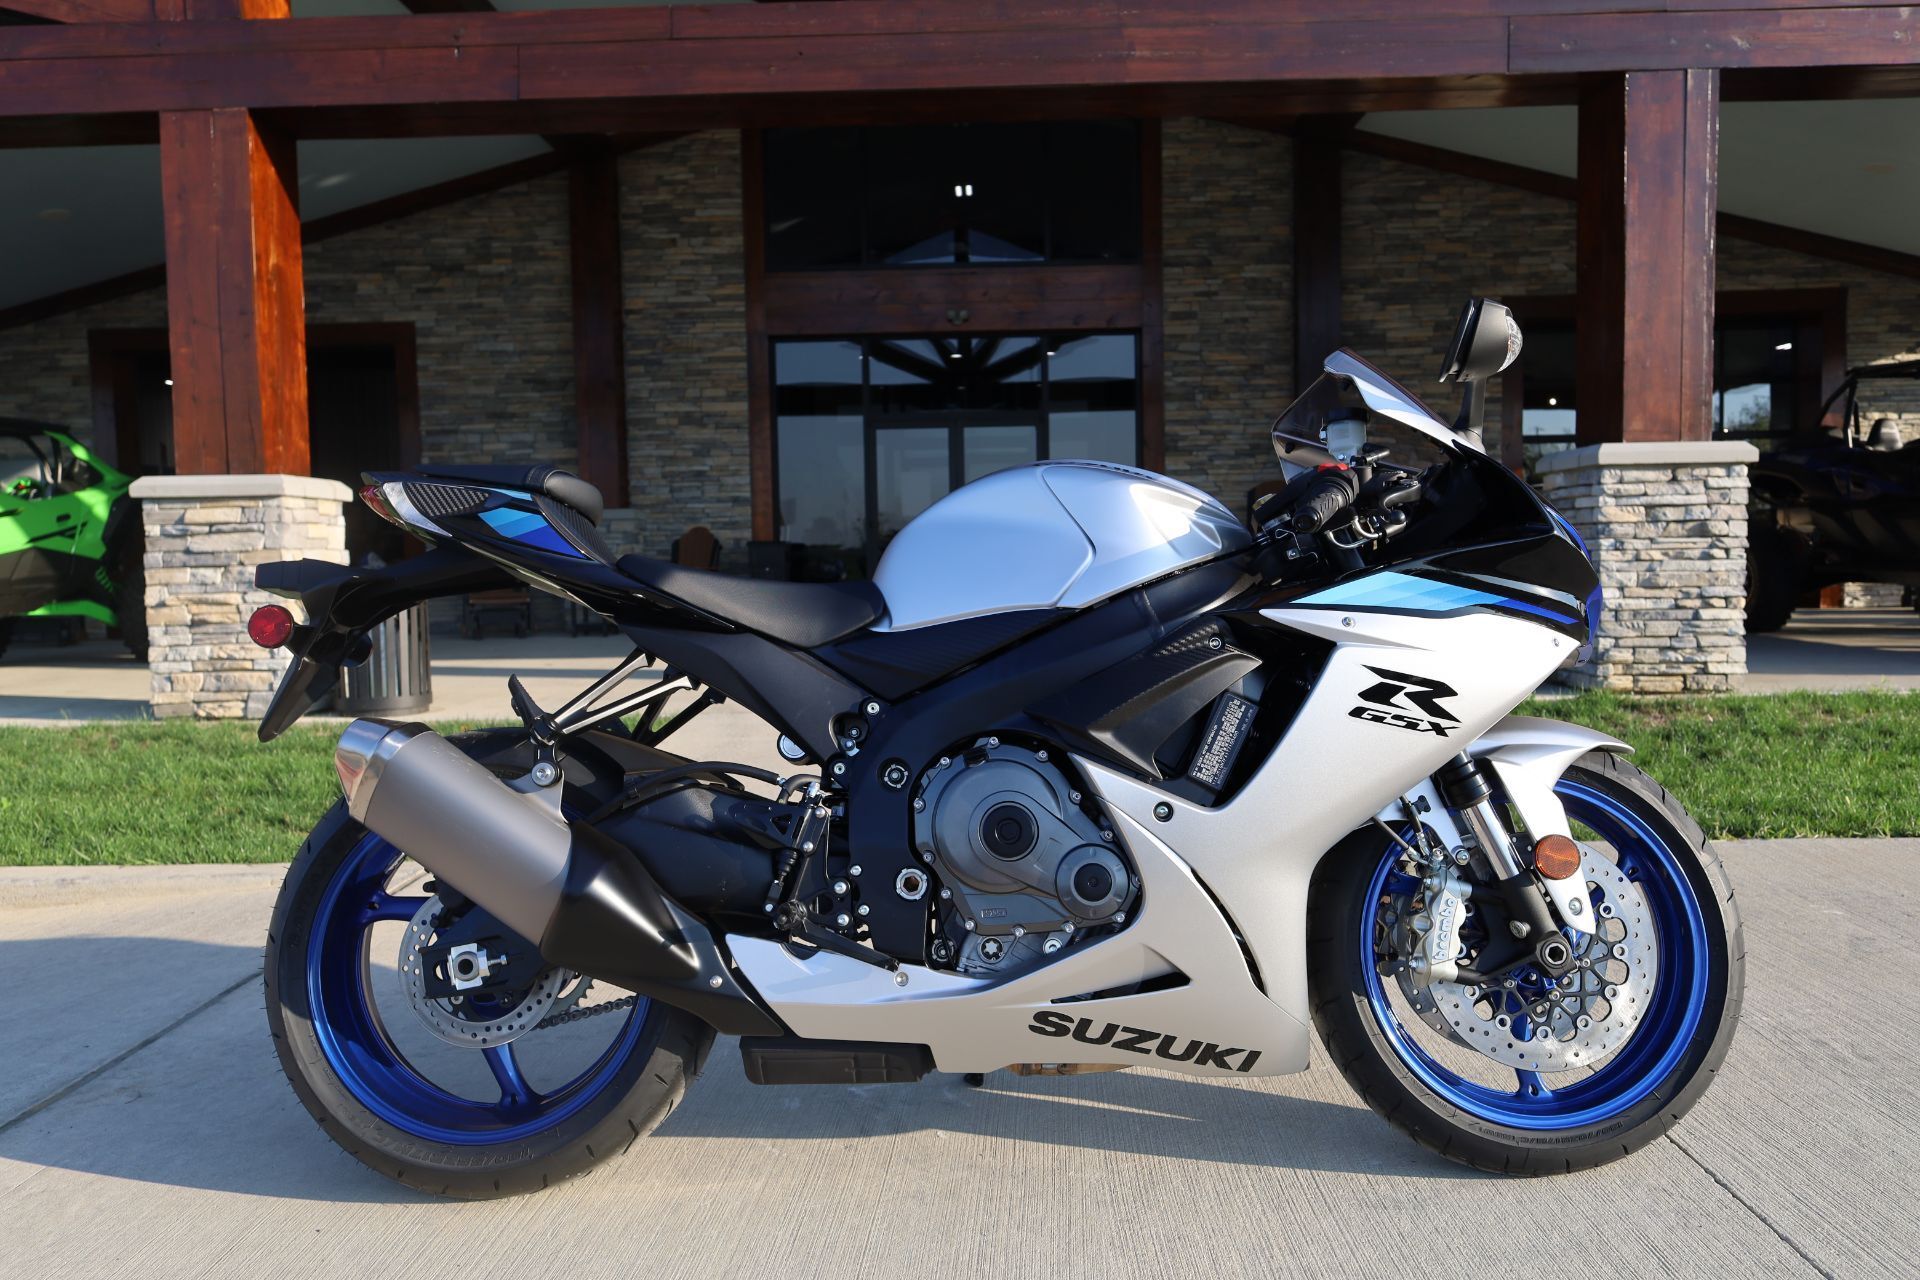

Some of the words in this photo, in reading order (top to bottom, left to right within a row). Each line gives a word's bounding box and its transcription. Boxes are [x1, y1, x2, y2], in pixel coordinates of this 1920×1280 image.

[1347, 706, 1461, 738] GSX
[1433, 897, 1457, 960] brembo
[1028, 1010, 1262, 1073] SUZUKI
